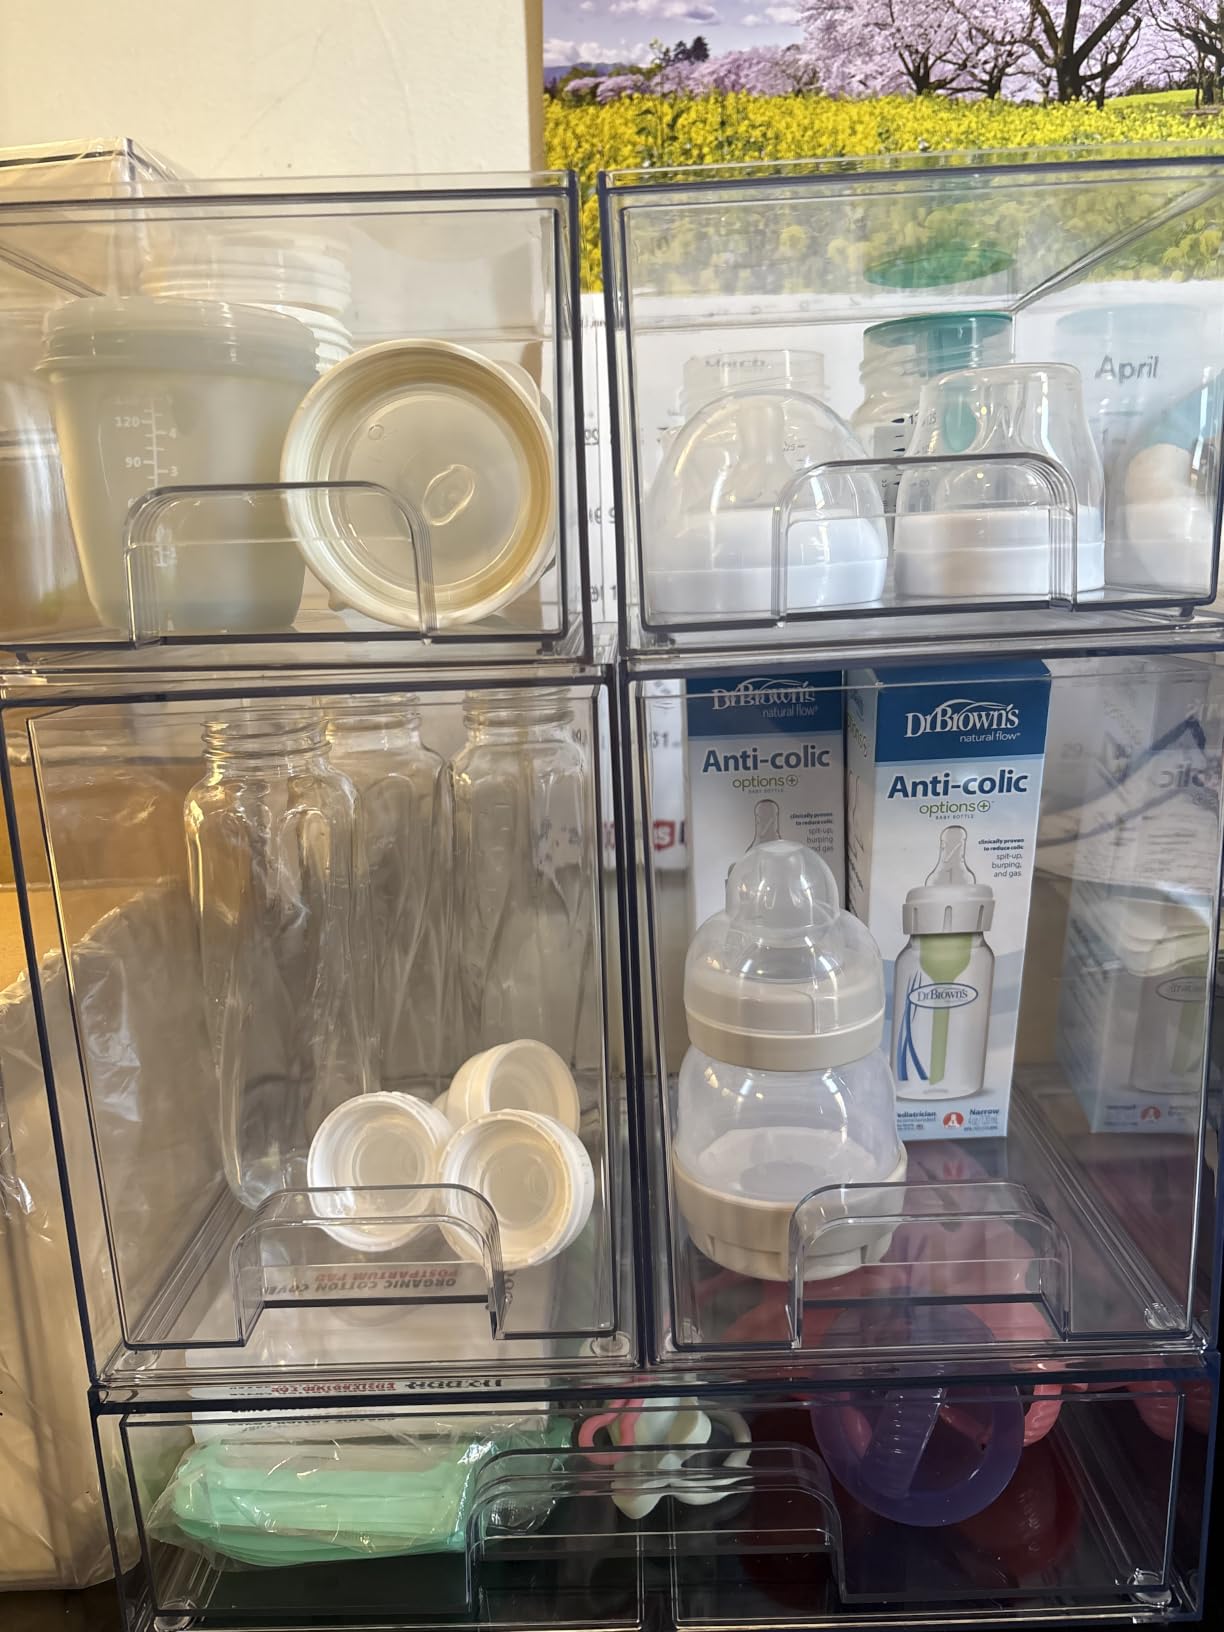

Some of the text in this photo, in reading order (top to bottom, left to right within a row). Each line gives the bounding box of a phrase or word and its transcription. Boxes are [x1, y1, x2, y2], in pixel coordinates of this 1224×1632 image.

[1094, 354, 1160, 384] April
[114, 416, 140, 428] 120
[167, 428, 177, 439] 4
[125, 456, 142, 468] 90
[169, 466, 179, 477] 3
[762, 703, 815, 718] natural flow
[960, 730, 1017, 743] natural flow
[702, 744, 831, 773] Anti-colic
[887, 769, 1029, 799] Anti-colic
[978, 837, 1003, 845] clinically
[993, 869, 1022, 878] and gas
[969, 1108, 1000, 1116] Narrow
[350, 1269, 459, 1282] POSTPARTUM
[315, 1279, 377, 1292] COTTON
[384, 1277, 456, 1290] ORGANIC
